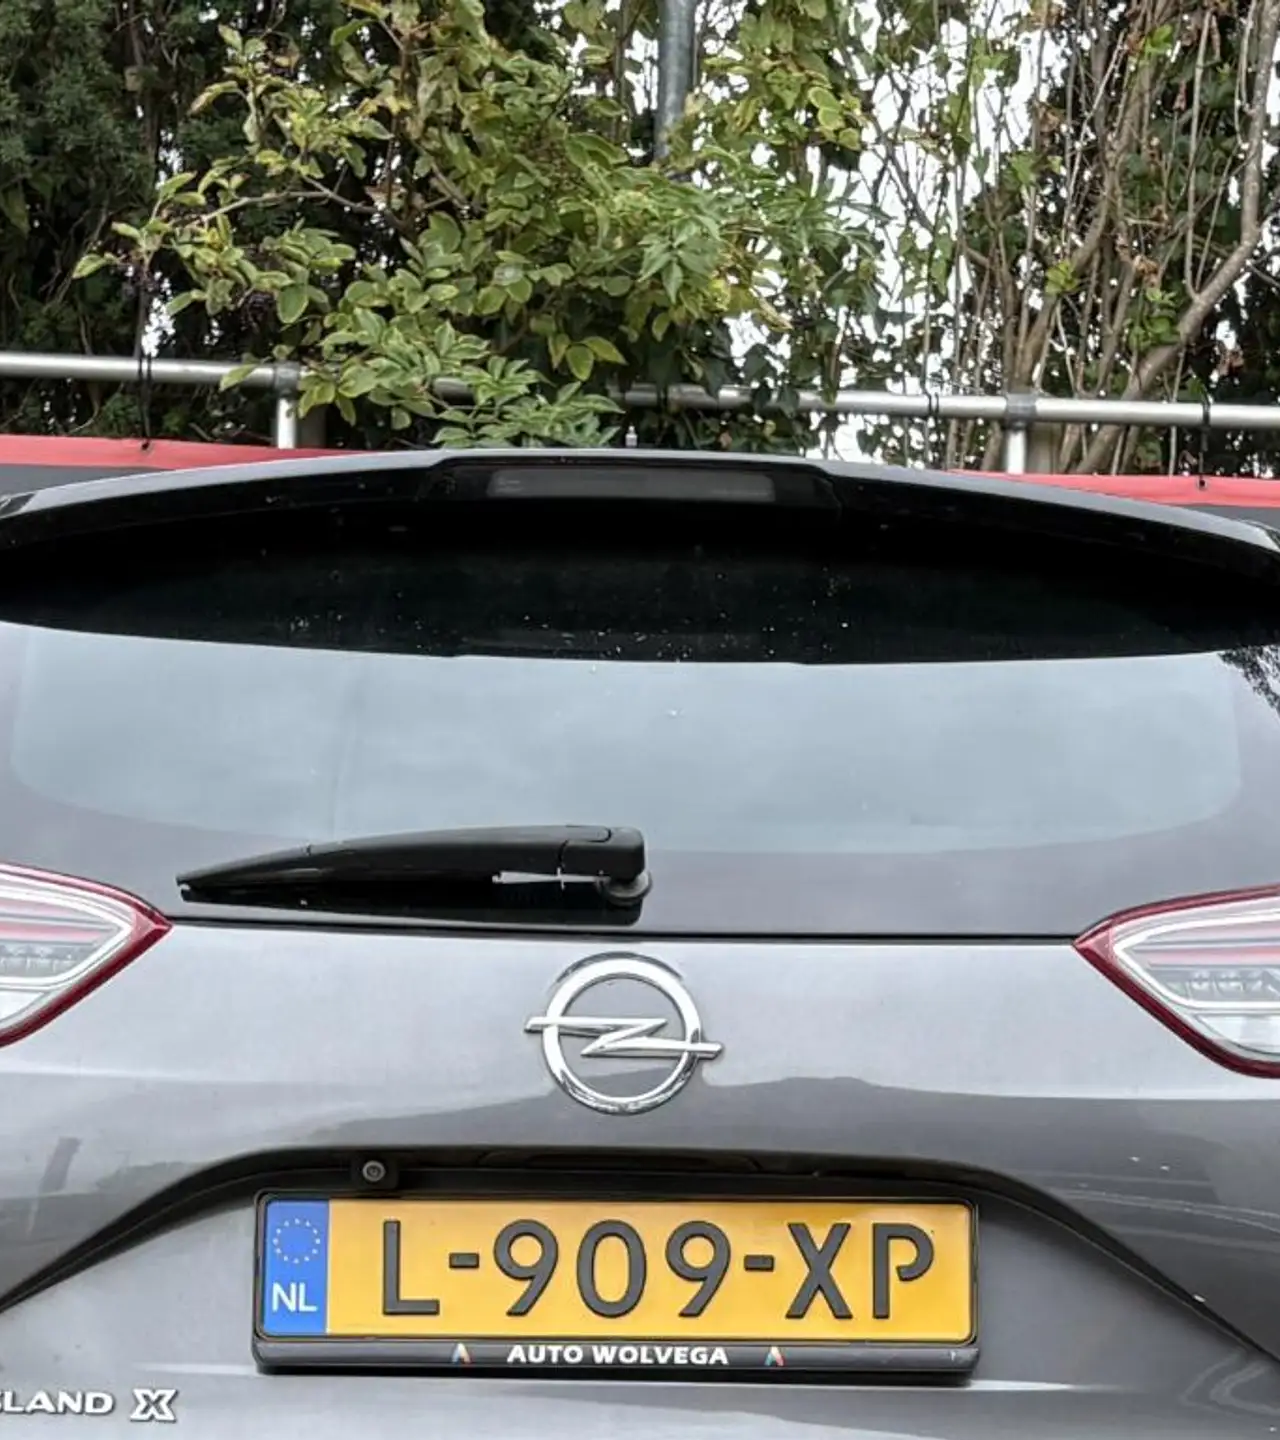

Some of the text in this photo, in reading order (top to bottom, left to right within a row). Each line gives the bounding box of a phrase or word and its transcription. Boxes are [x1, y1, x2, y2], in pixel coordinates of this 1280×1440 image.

[381, 1219, 934, 1320] L-909-XP
[271, 1282, 317, 1313] NL
[507, 1344, 729, 1365] AUTO WOLVEGA
[129, 1388, 178, 1422] X
